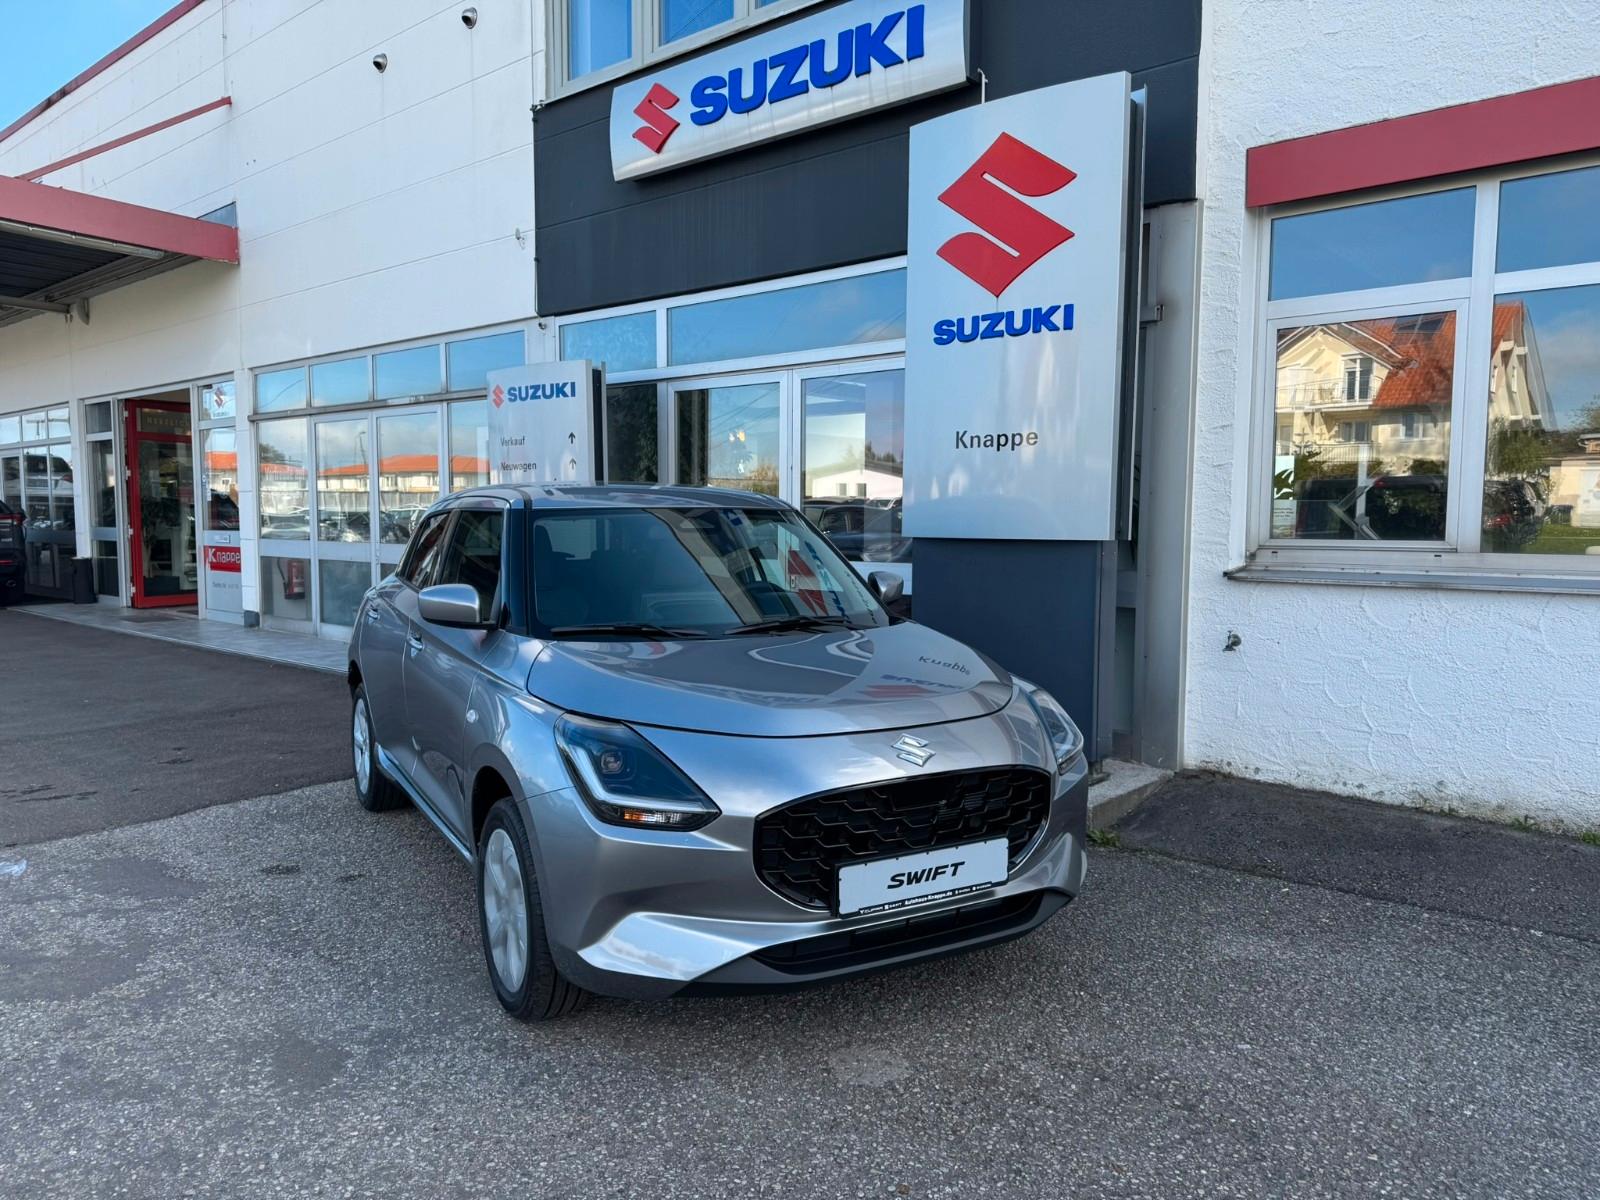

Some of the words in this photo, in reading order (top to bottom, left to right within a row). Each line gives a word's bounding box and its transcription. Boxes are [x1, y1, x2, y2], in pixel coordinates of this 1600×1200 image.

[690, 4, 925, 126] SUZUKI
[933, 303, 1074, 346] SUZUKI
[507, 381, 576, 402] SUZUKI
[501, 436, 525, 447] Verkauf
[955, 430, 1039, 452] Knappe
[501, 462, 537, 473] Neuwagen
[208, 548, 241, 564] Knappe
[887, 861, 965, 889] SWIFT
